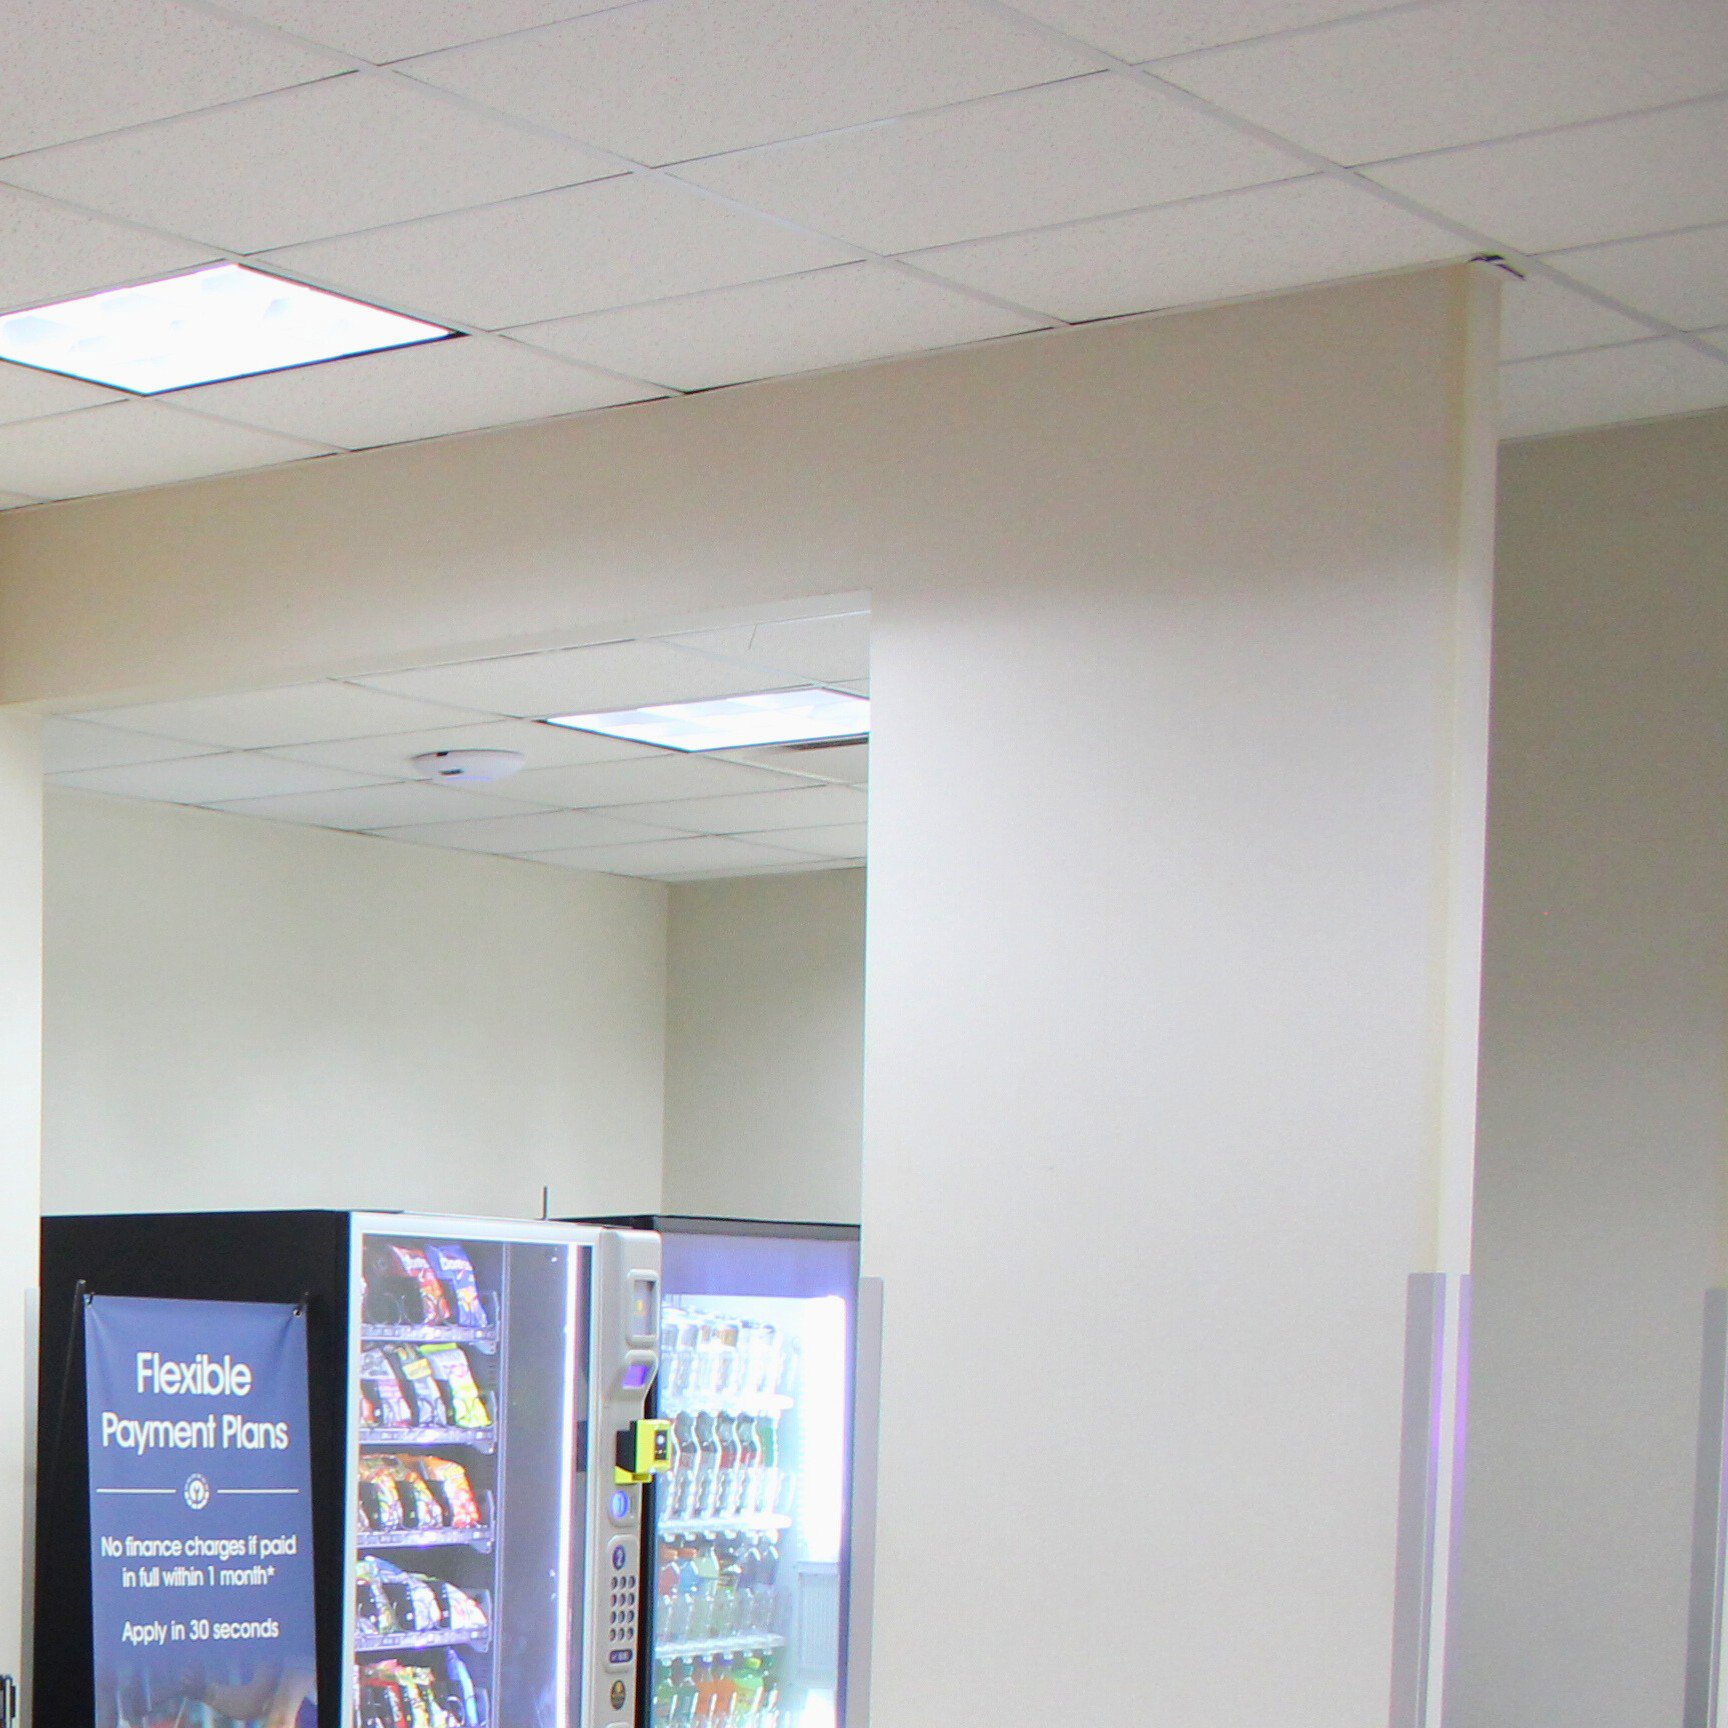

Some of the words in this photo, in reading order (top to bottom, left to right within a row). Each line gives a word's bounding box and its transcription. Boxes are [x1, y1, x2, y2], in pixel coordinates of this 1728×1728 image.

[137, 1352, 252, 1396] Flexible
[102, 1411, 216, 1455] Payment
[222, 1414, 289, 1450] Plans
[101, 1536, 123, 1557] No
[125, 1535, 182, 1557] finance
[185, 1535, 245, 1561] charges
[248, 1535, 258, 1555] if
[260, 1535, 297, 1559] paid
[122, 1567, 136, 1588] in
[139, 1566, 160, 1587] full
[163, 1566, 204, 1586] within
[208, 1566, 215, 1586] 1
[122, 1620, 167, 1645] Apply
[171, 1620, 185, 1640] in
[190, 1619, 209, 1640] 30
[213, 1617, 279, 1639] seconds
